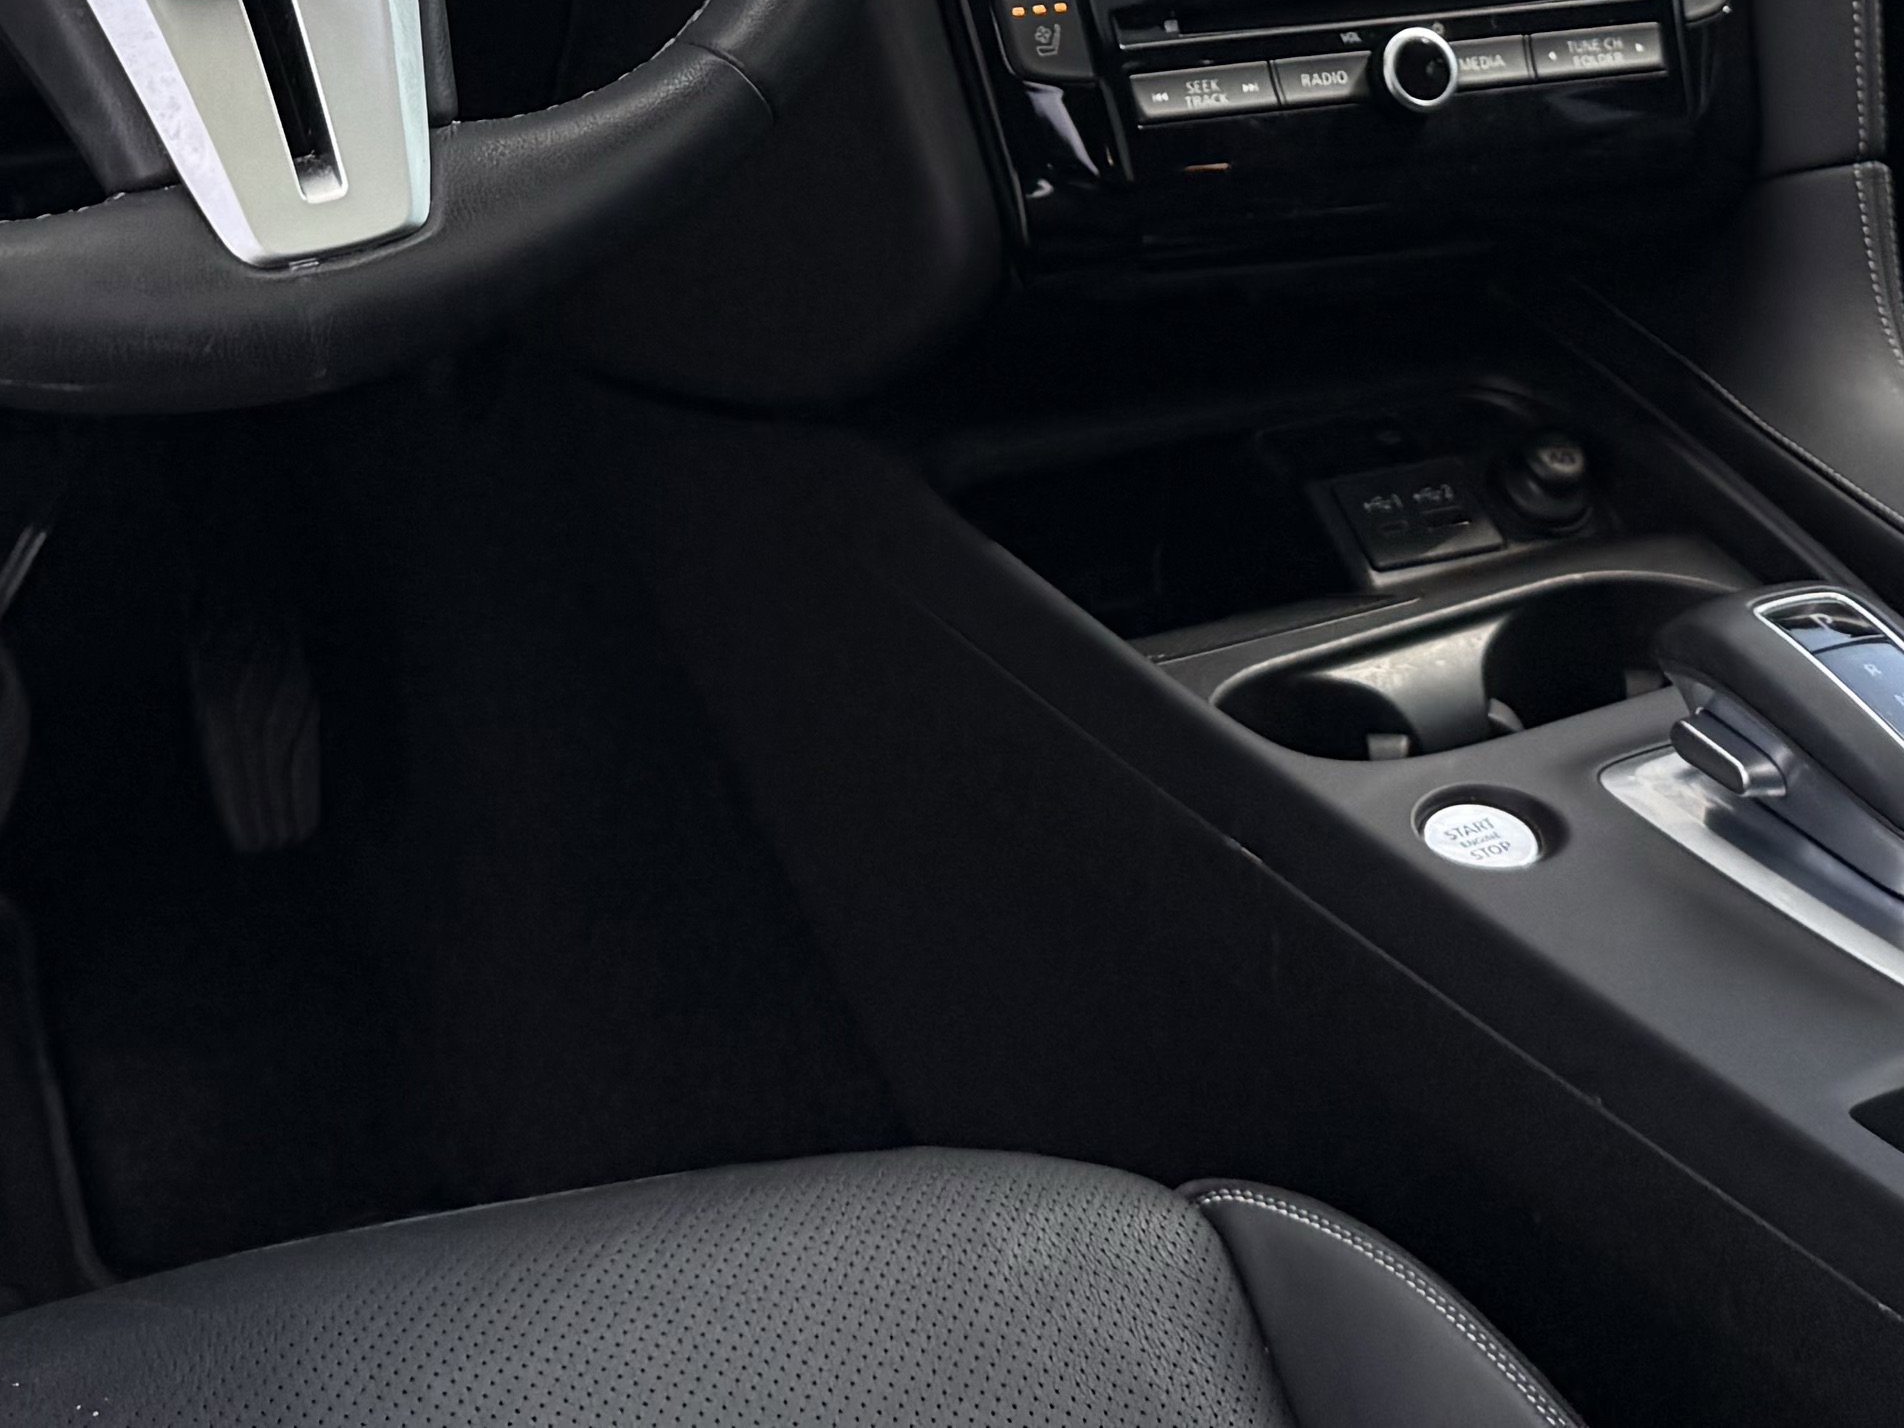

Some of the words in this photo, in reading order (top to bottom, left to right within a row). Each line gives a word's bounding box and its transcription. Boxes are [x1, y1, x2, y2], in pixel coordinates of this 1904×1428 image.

[1458, 54, 1507, 72] MEDIA
[1185, 79, 1222, 94] SEEK
[1300, 70, 1348, 87] RADIO
[1184, 93, 1229, 110] TRACK
[1863, 663, 1882, 678] R
[1444, 817, 1496, 841] START
[1470, 840, 1511, 860] STOP
